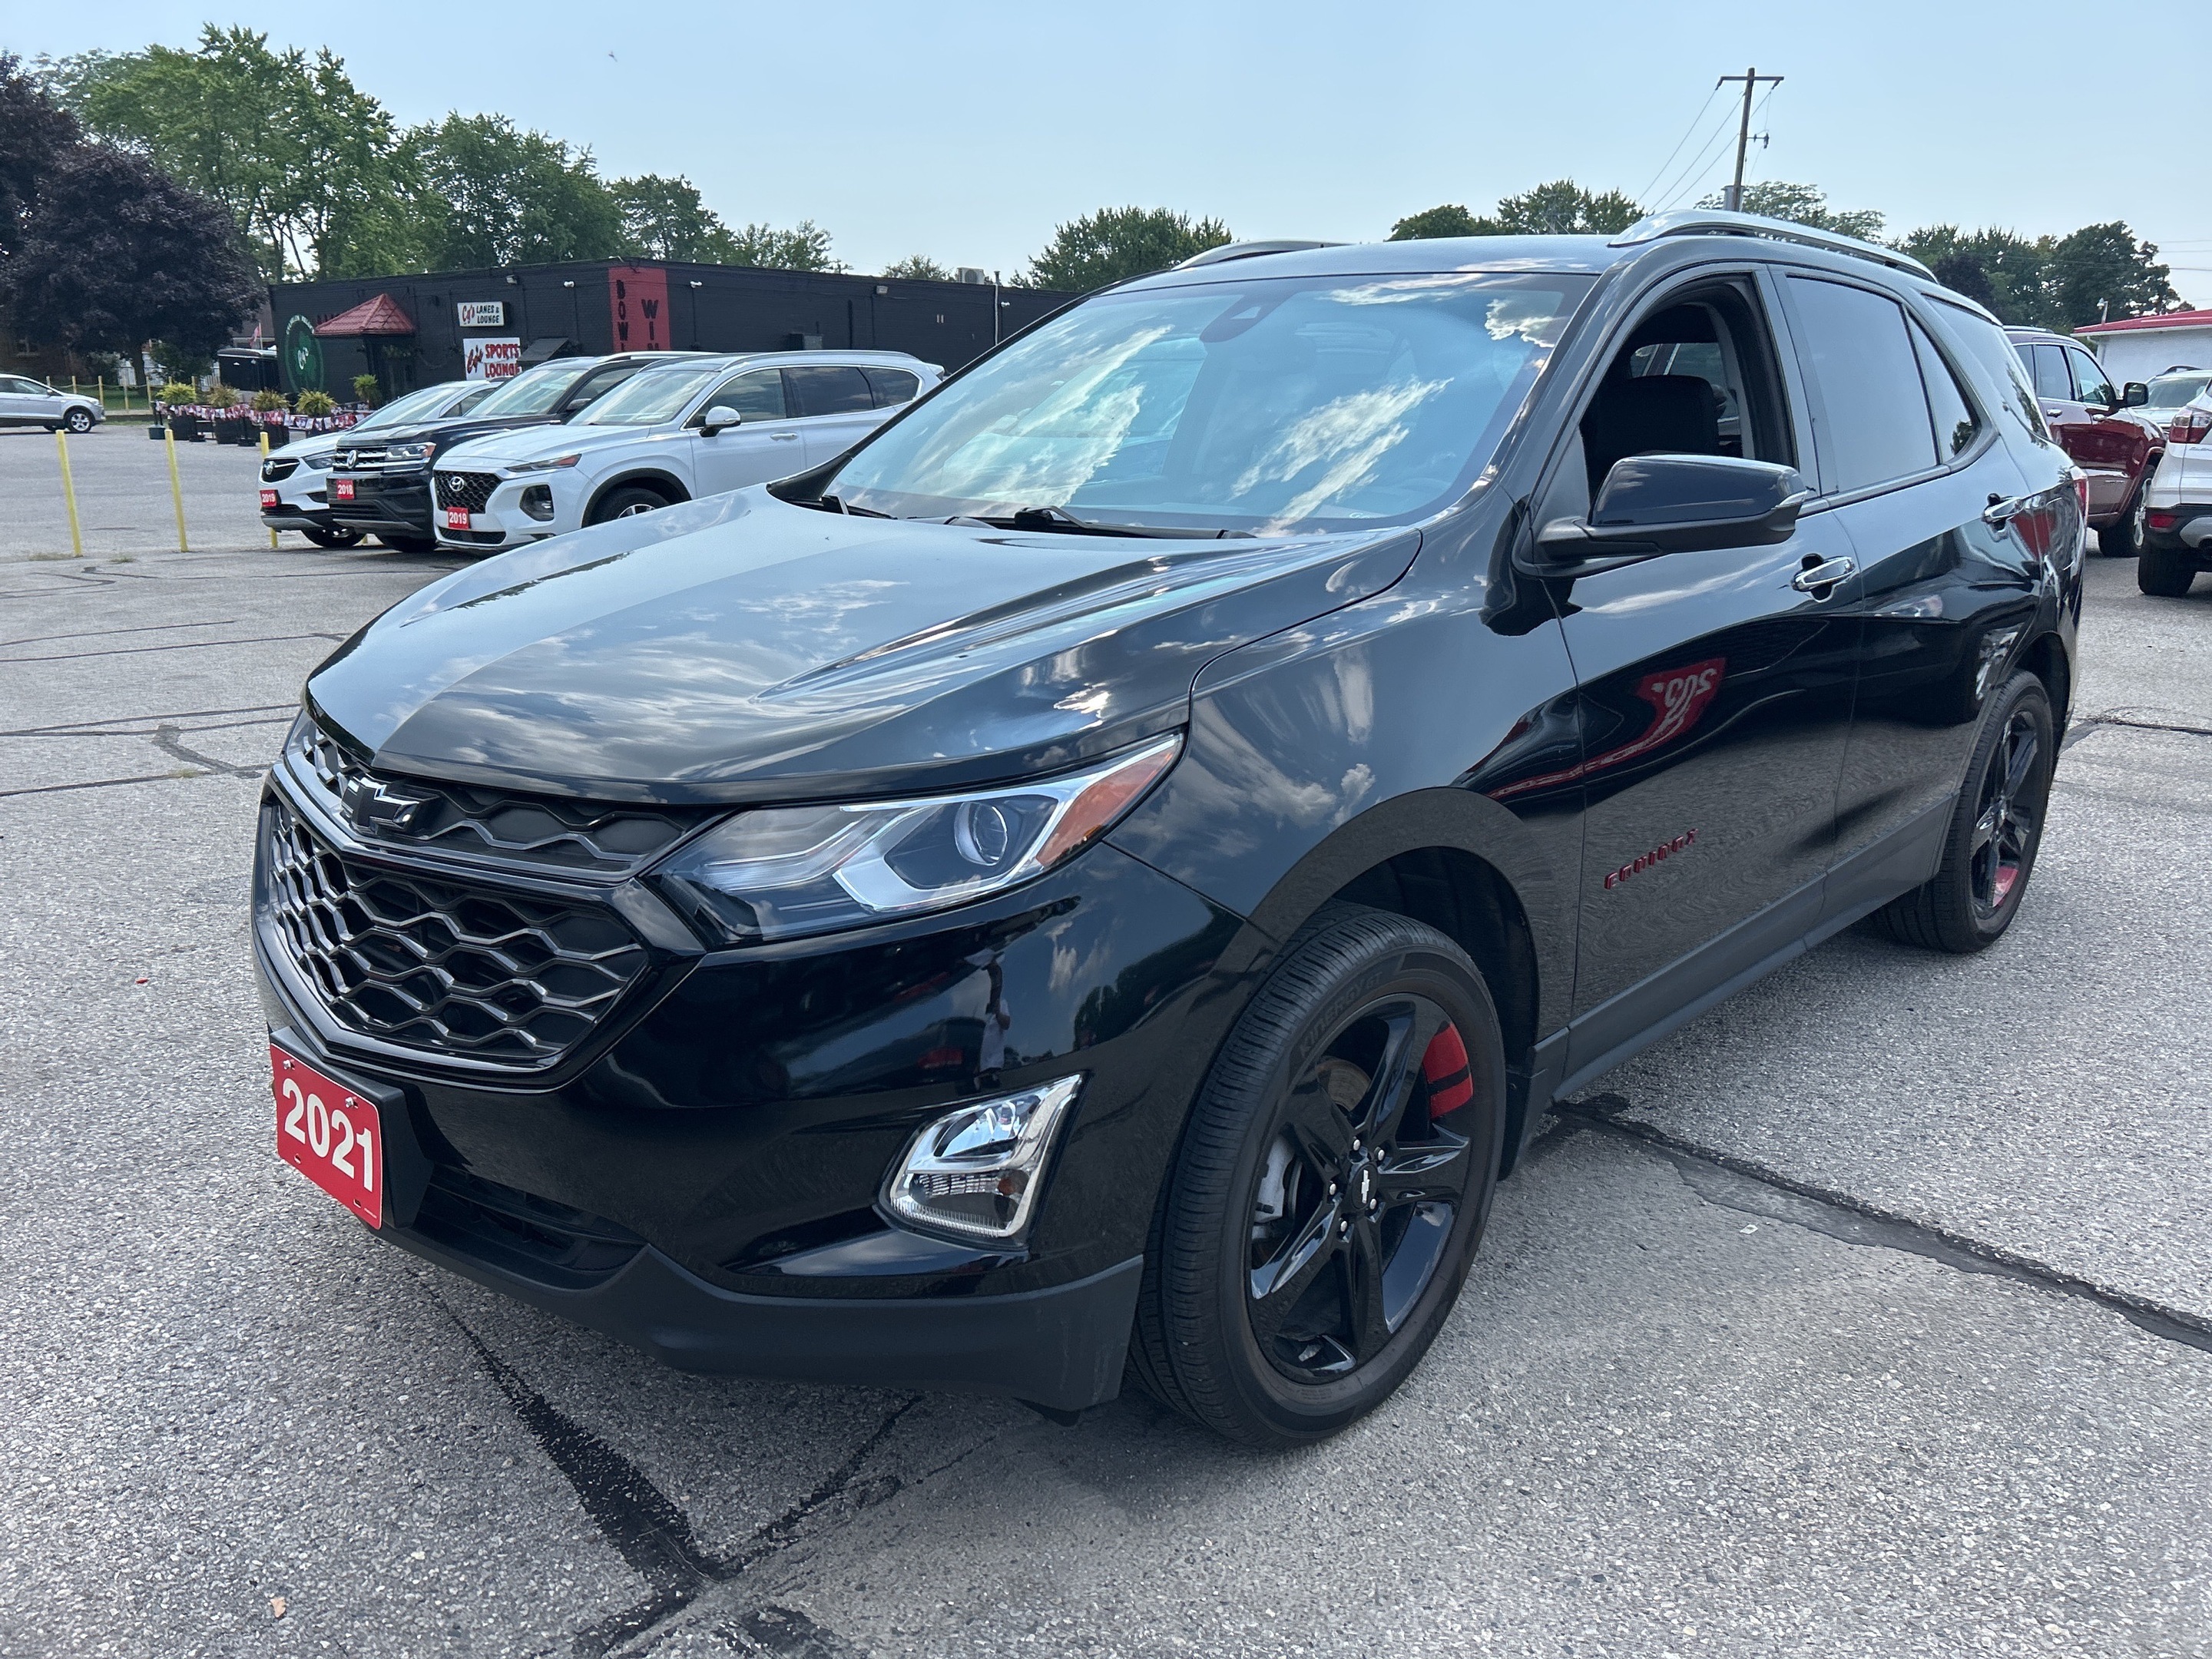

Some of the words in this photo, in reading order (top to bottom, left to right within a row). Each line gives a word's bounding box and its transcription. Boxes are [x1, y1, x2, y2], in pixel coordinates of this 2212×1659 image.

[476, 305, 495, 314] LANES
[477, 315, 500, 324] LOUNGE
[485, 343, 520, 359] SPORTS
[338, 484, 353, 495] 2018
[262, 493, 276, 503] 2019
[449, 512, 467, 525] 2019
[282, 1078, 373, 1193] 2021
